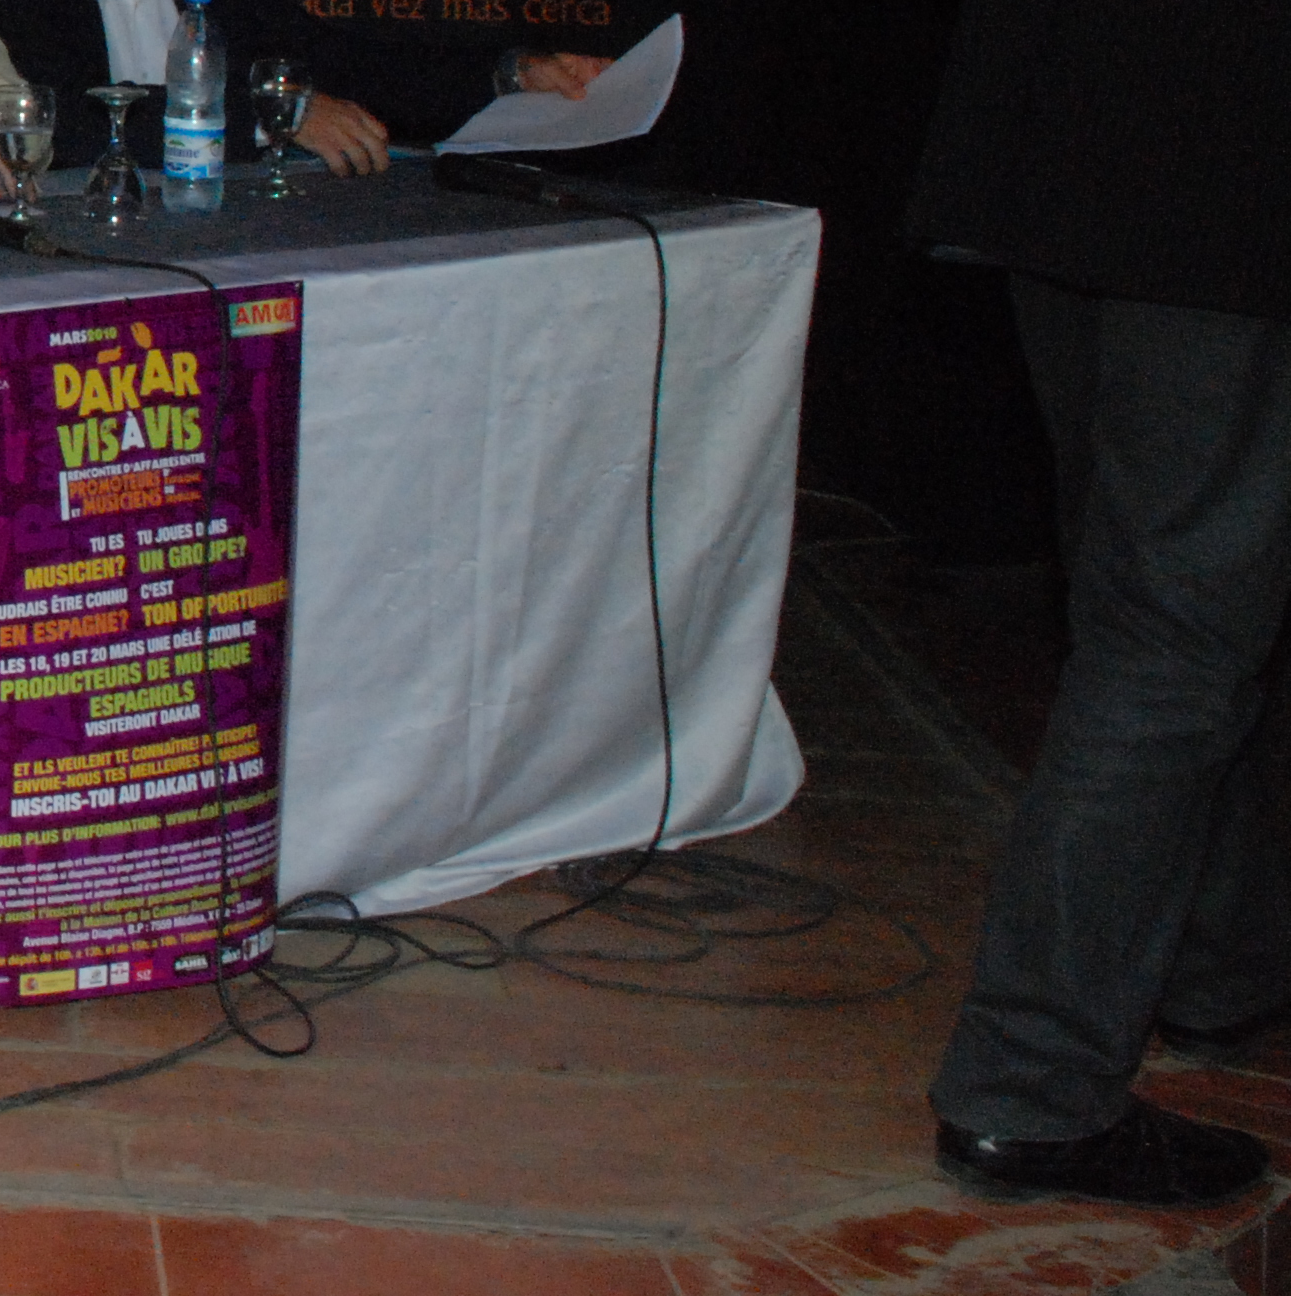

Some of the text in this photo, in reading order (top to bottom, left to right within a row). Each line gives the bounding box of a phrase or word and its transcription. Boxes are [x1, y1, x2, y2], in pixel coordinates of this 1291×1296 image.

[52, 348, 200, 416] DAKAR
[68, 463, 122, 480] RENCONTRE
[90, 536, 106, 552] TU
[109, 533, 124, 550] ES
[137, 529, 152, 545] TU
[155, 523, 193, 543] JOUES
[24, 555, 126, 590] MUSICIEN?
[139, 549, 164, 573] UN
[51, 595, 83, 614] ÊTRE
[86, 587, 129, 607] CONNU
[140, 579, 174, 599] C'EST
[0, 624, 27, 648] EN
[33, 609, 129, 644] ESPAGNE?
[141, 600, 177, 627] TON
[0, 620, 257, 675] LES 18, 19 ET 20 MARS UNE DÉLÉATION DE
[0, 662, 142, 702] PRODUCTEURS
[147, 657, 170, 681] DE
[90, 679, 196, 718] ESPAGNOLS
[85, 703, 201, 737] VISITERONT DAKAR
[13, 762, 30, 777] ET
[33, 758, 54, 775] ILS
[57, 751, 112, 772] VEULENT
[116, 749, 129, 763] TE
[13, 771, 101, 794] ENVOIE-NOUS
[104, 766, 127, 783] TES
[11, 787, 115, 818] INSCRIS-TOI
[118, 783, 141, 805] AU
[144, 773, 199, 800] DAKAR
[227, 760, 238, 784] À
[25, 830, 59, 846] PLUS
